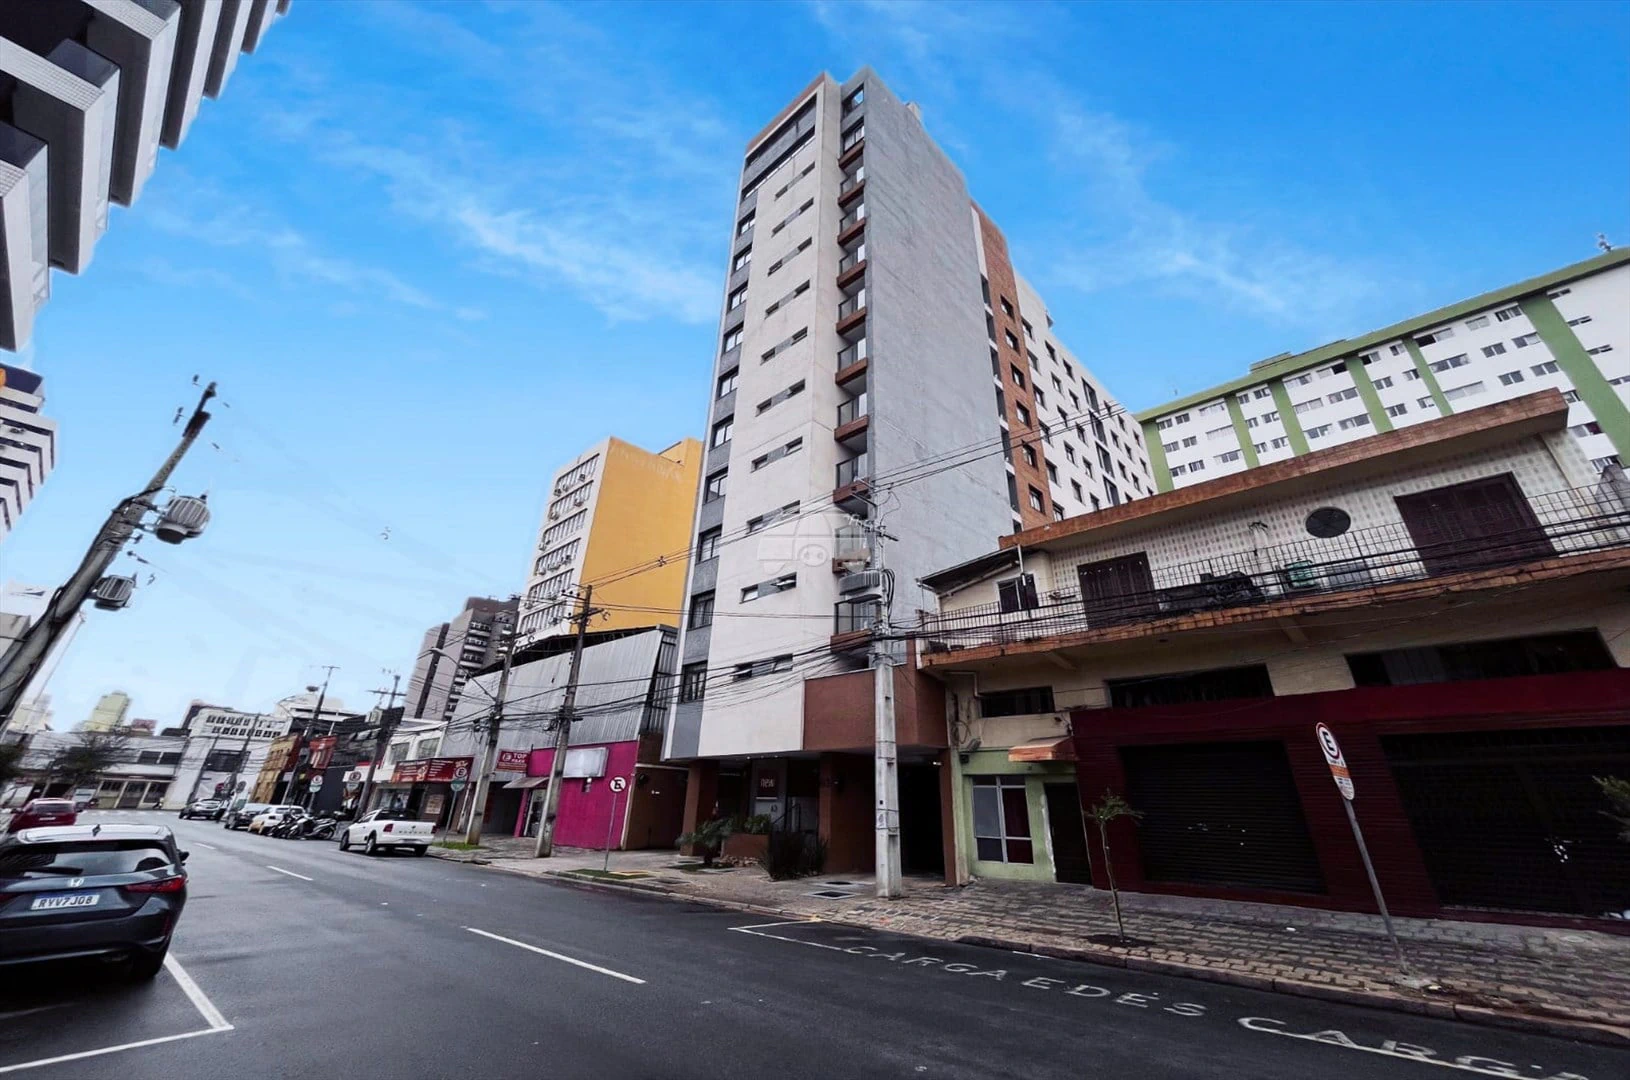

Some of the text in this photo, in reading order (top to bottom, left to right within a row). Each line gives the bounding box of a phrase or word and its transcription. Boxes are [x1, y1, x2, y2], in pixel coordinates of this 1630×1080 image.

[1322, 730, 1336, 752] E
[513, 752, 528, 760] TOP
[846, 946, 1008, 981] CARGA
